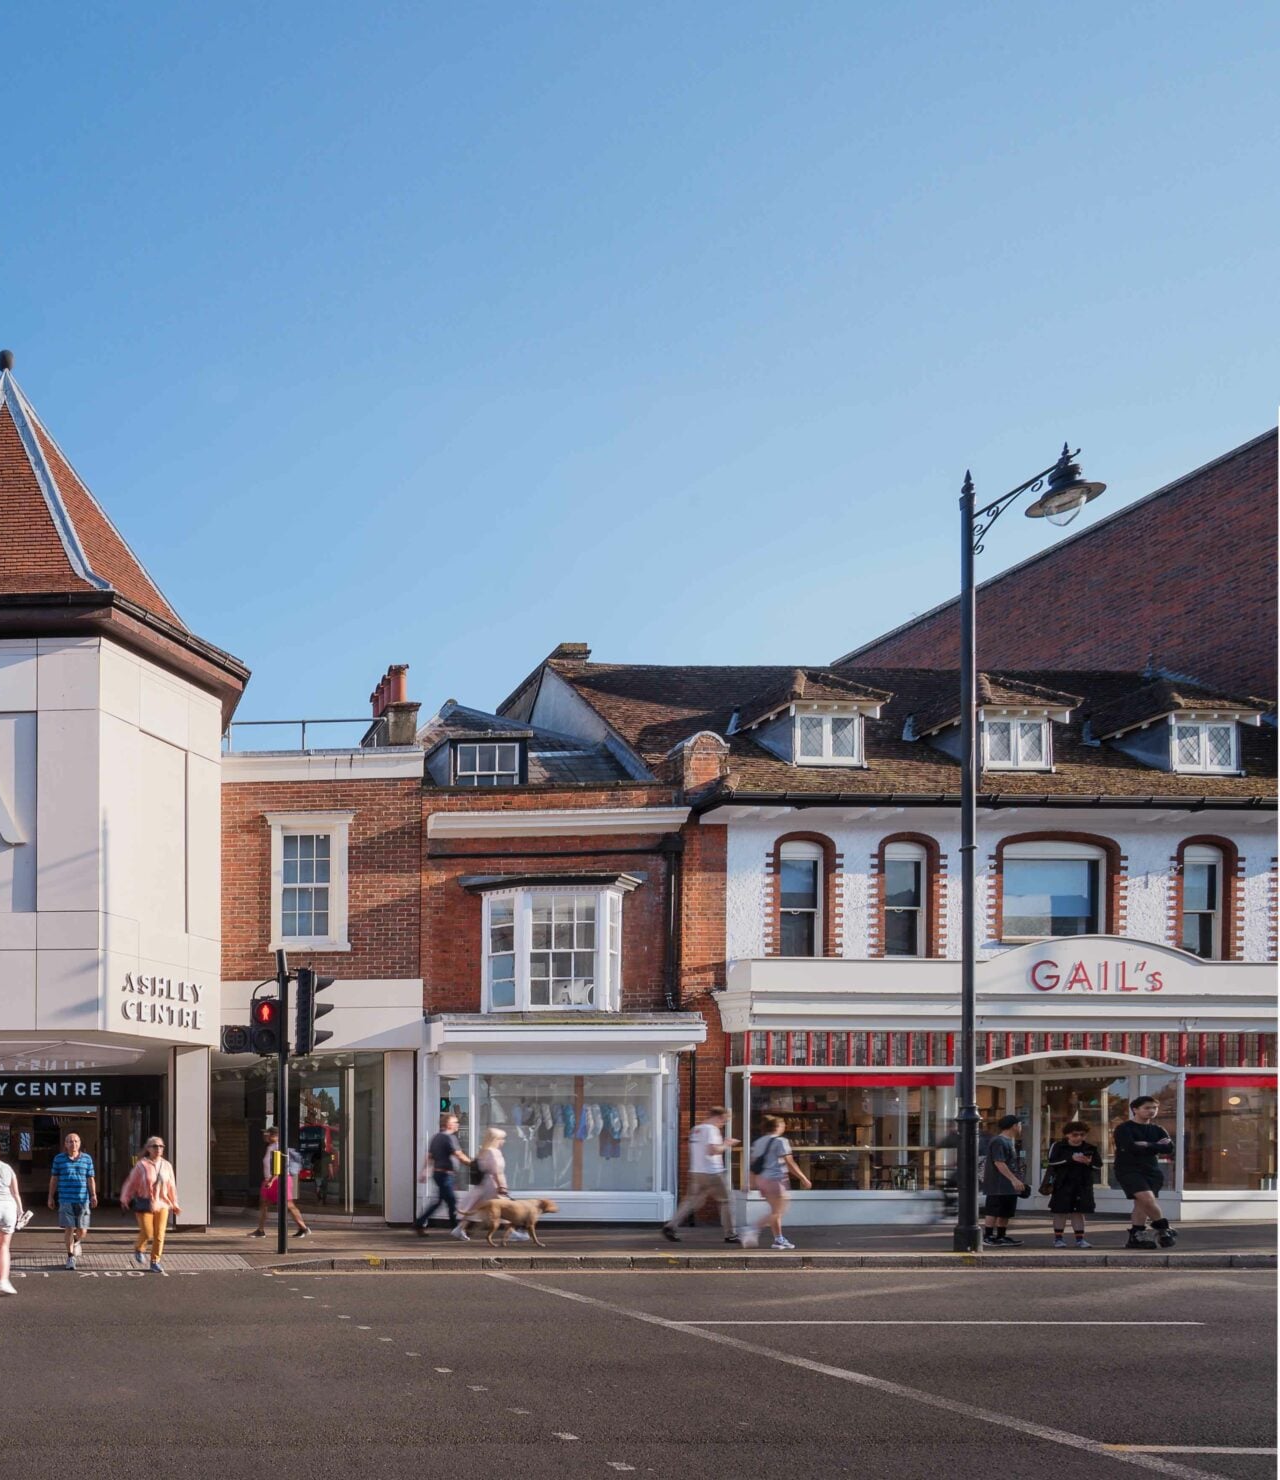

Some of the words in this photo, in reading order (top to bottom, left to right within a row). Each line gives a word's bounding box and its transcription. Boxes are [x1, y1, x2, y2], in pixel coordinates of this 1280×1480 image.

[120, 970, 204, 1005] ASHLEY
[1029, 959, 1164, 992] GAIL's
[120, 1000, 204, 1031] CENTRE
[14, 1082, 102, 1096] CENTRE
